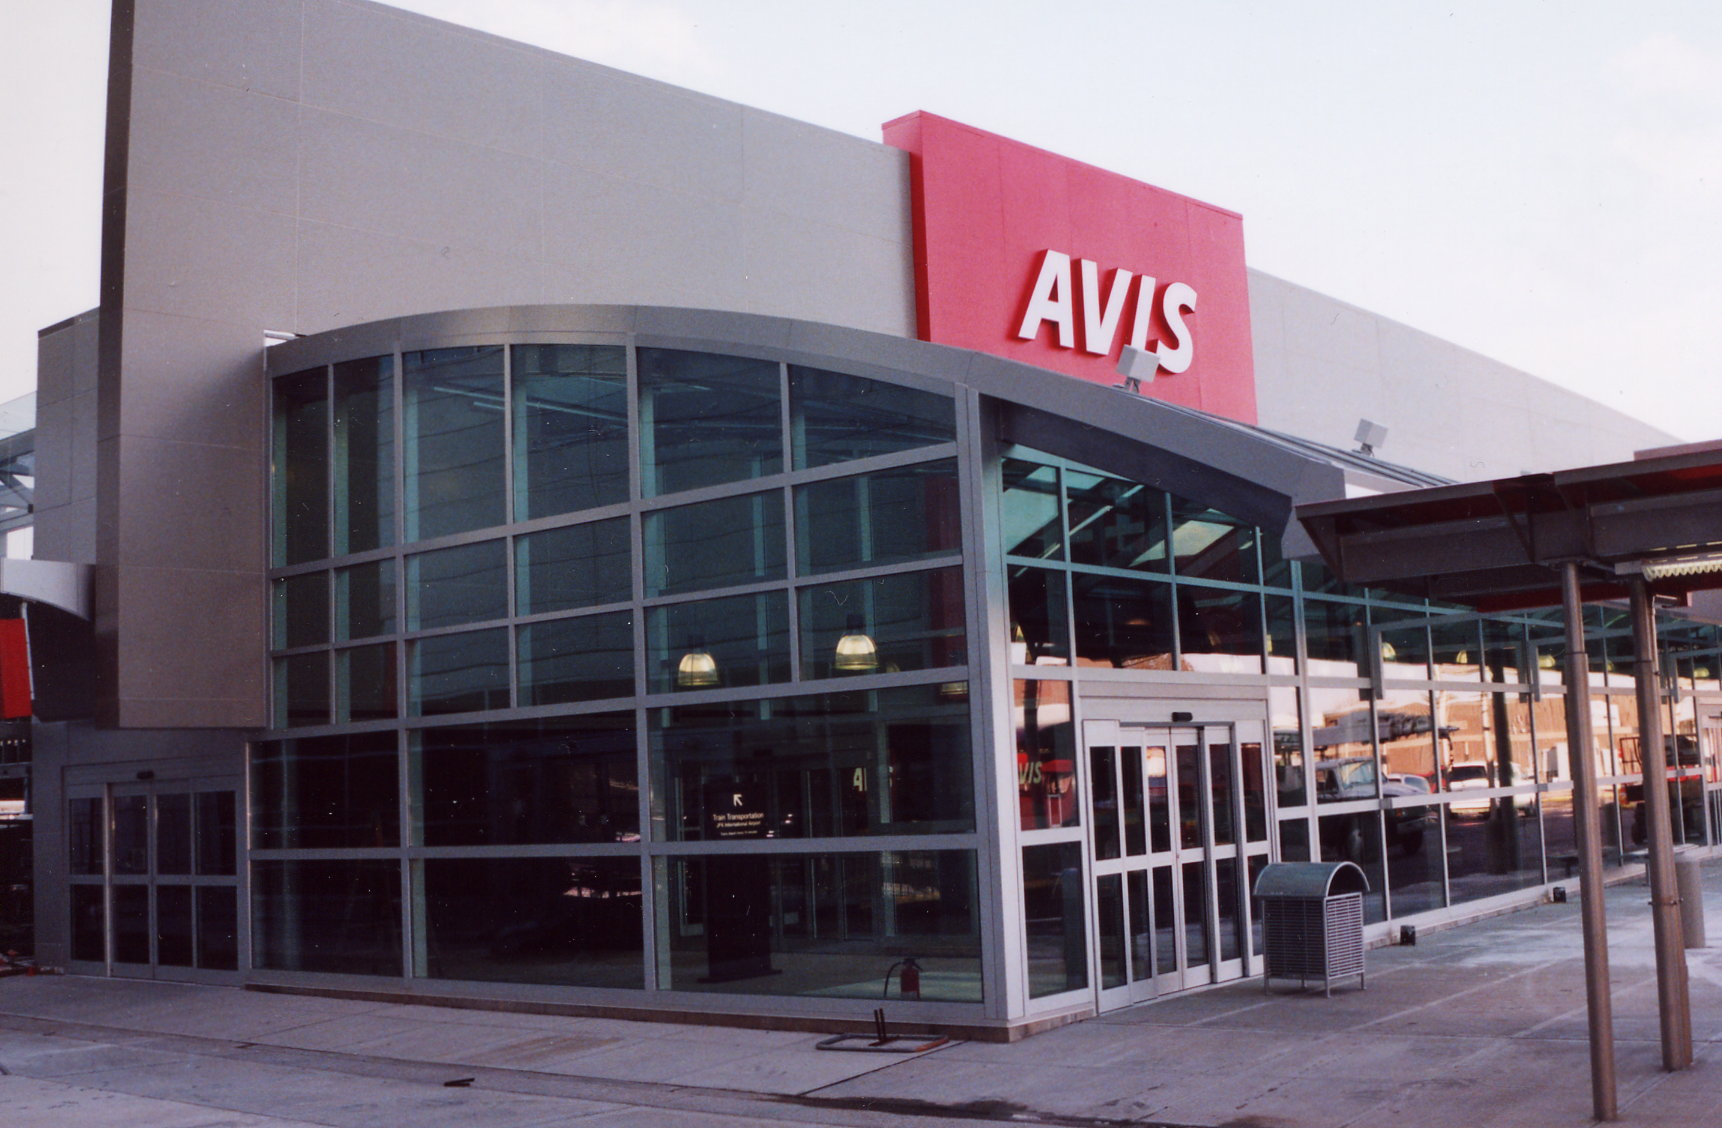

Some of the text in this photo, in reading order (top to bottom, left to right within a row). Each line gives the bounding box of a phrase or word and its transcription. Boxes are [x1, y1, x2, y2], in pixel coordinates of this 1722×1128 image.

[1017, 249, 1198, 374] AVIS
[1019, 760, 1043, 784] VIS
[727, 812, 764, 821] Transportation
